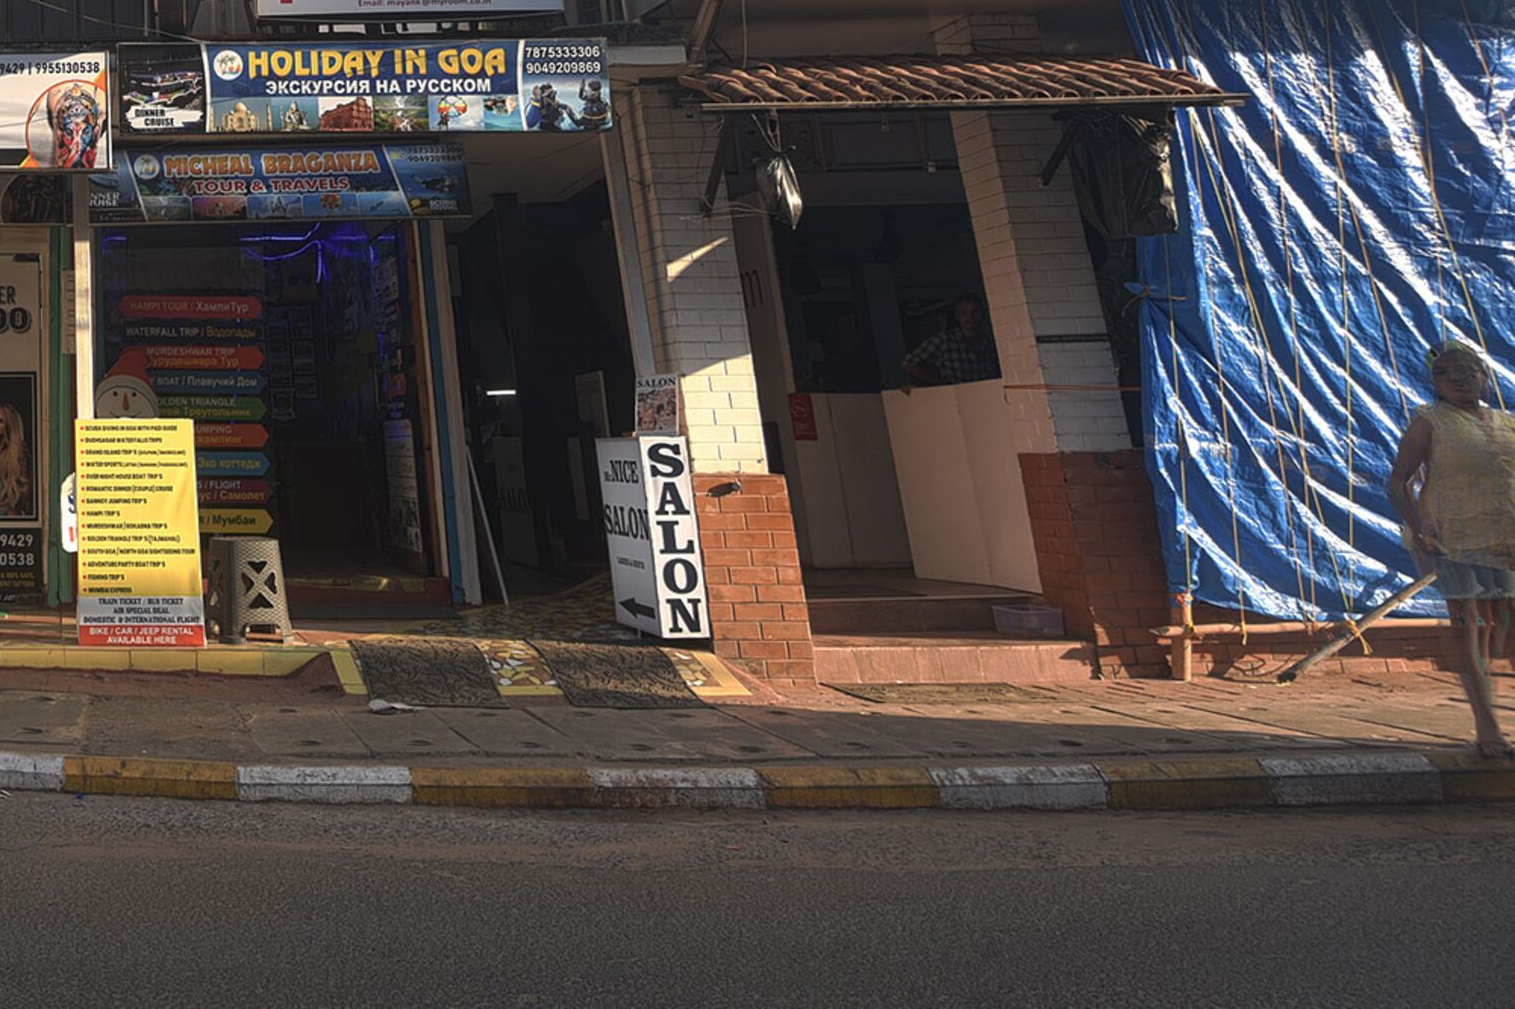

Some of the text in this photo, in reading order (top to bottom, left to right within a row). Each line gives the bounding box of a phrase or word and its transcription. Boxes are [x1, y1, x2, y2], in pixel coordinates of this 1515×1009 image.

[525, 46, 600, 58] 7875333306
[36, 62, 100, 74] 9955130538
[248, 47, 506, 79] HOLIDAY IN GOA
[526, 62, 601, 74] 9049209869
[266, 78, 491, 95] ЭКСКУРСИЯ НА РУССКОМ
[145, 118, 174, 126] CRUISE
[163, 151, 381, 177] MICHEAL BRAGANZA
[193, 176, 351, 194] TOUR & TRAVELS
[126, 326, 177, 338] WATERFALL
[180, 326, 199, 337] TRIP
[157, 376, 180, 386] BOAT
[636, 377, 676, 389] SALON
[157, 397, 236, 407] OLDEN TRIANGLE
[209, 480, 241, 490] FLIGHT
[604, 503, 650, 541] SALON
[647, 443, 703, 634] SALON
[89, 627, 194, 635] BIKE CAR JEEP RENTAL
[107, 636, 177, 645] AVAILABLE HERE
